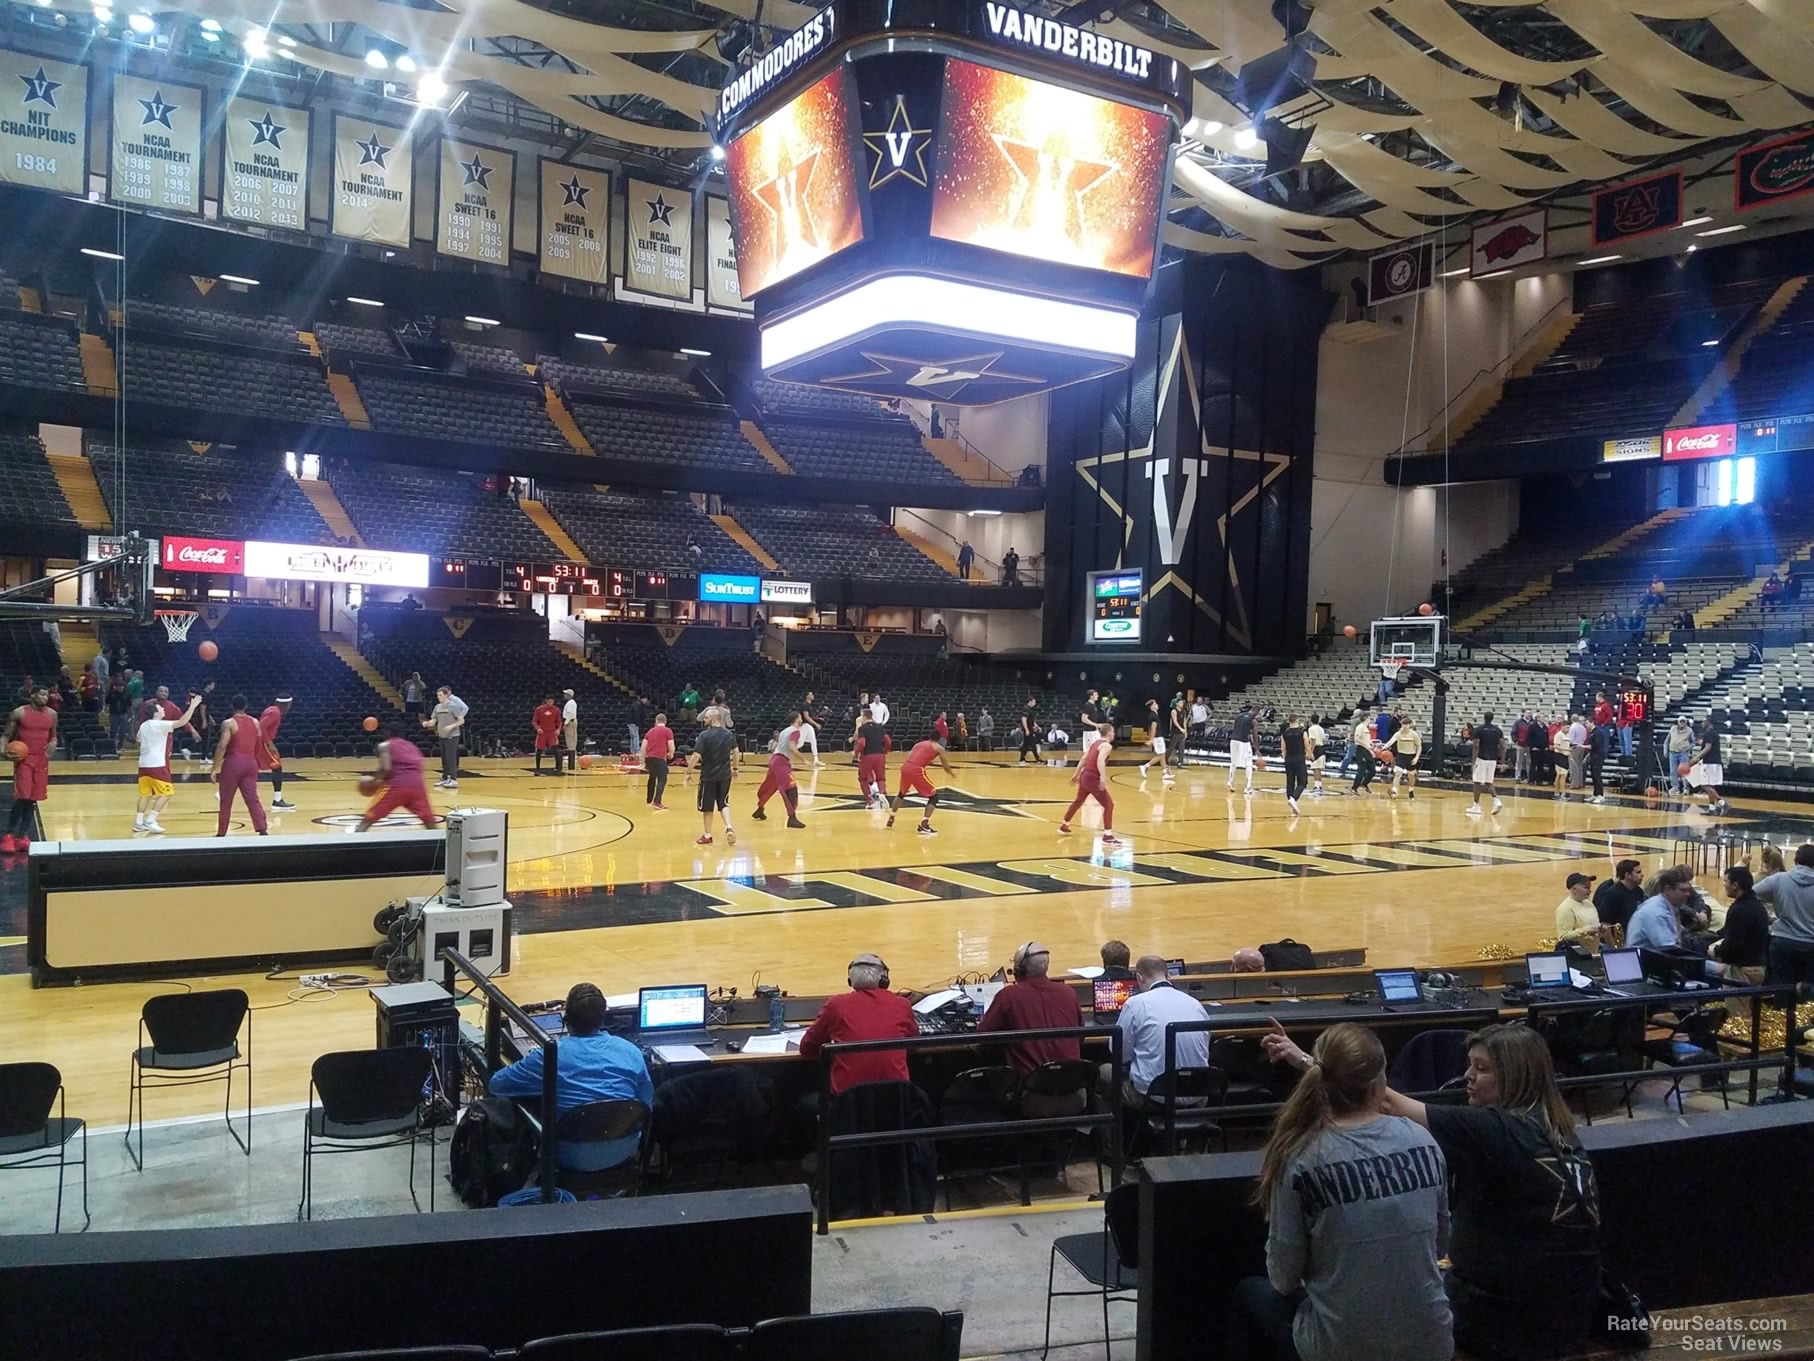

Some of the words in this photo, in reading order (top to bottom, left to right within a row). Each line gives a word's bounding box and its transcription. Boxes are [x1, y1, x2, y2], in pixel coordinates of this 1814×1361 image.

[986, 2, 1152, 78] VANDERBILT
[722, 13, 824, 114] COMMODORES
[33, 79, 48, 97] V
[28, 110, 51, 127] NIT
[150, 103, 165, 119] V
[0, 120, 77, 145] CHAMPIONS
[261, 124, 274, 140] V
[143, 133, 171, 148] NCAA
[122, 141, 191, 164] TOURNAMENT
[367, 144, 380, 160] V
[885, 132, 912, 167] V
[15, 152, 57, 174] 1984
[124, 156, 151, 170] 1986
[164, 163, 191, 177] 1987
[253, 153, 280, 168] NCAA
[233, 161, 299, 183] TOURNAMENT
[360, 173, 385, 187] NCAA
[471, 165, 483, 180] V
[124, 170, 151, 185] 1989
[164, 177, 191, 192] 1998
[234, 175, 262, 189] 2006
[272, 182, 298, 196] 2007
[123, 185, 151, 200] 2000
[163, 192, 191, 206] 2003
[342, 180, 403, 202] TOURNAMENT
[569, 186, 580, 201] V
[233, 191, 261, 205] 2010
[271, 197, 297, 211] 2011
[342, 194, 368, 208] 2014
[464, 192, 488, 208] NCAA
[233, 206, 261, 220] 2012
[271, 212, 298, 225] 2013
[454, 202, 482, 217] SWEET
[485, 208, 497, 220] 16
[655, 203, 665, 218] V
[448, 213, 471, 227] 1990
[480, 220, 502, 233] 1991
[564, 212, 585, 227] NCAA
[448, 226, 470, 240] 1994
[480, 233, 503, 247] 1995
[555, 222, 581, 236] SWEET
[583, 228, 594, 239] 16
[650, 230, 670, 243] NCAA
[447, 239, 470, 253] 1997
[479, 246, 503, 260] 2004
[548, 232, 570, 246] 2005
[578, 238, 600, 252] 2008
[638, 239, 657, 252] ELITE
[660, 243, 682, 257] EIGHT
[548, 246, 570, 259] 2009
[636, 262, 656, 275] 2001
[664, 268, 686, 281] 2002
[1145, 458, 1208, 565] V
[178, 546, 228, 564] Coca-Cola
[516, 566, 524, 577] 4
[555, 565, 586, 577] 53:11
[614, 572, 622, 582] 4
[523, 580, 531, 591] 0
[548, 582, 556, 593] 0
[569, 585, 573, 593] 1
[591, 584, 599, 595] 0
[614, 585, 621, 596] 0
[774, 586, 809, 595] LOTTERY
[453, 619, 464, 630] C
[665, 629, 675, 639] D
[863, 635, 873, 645] E
[1623, 692, 1647, 703] 53:11
[1627, 703, 1643, 719] 30
